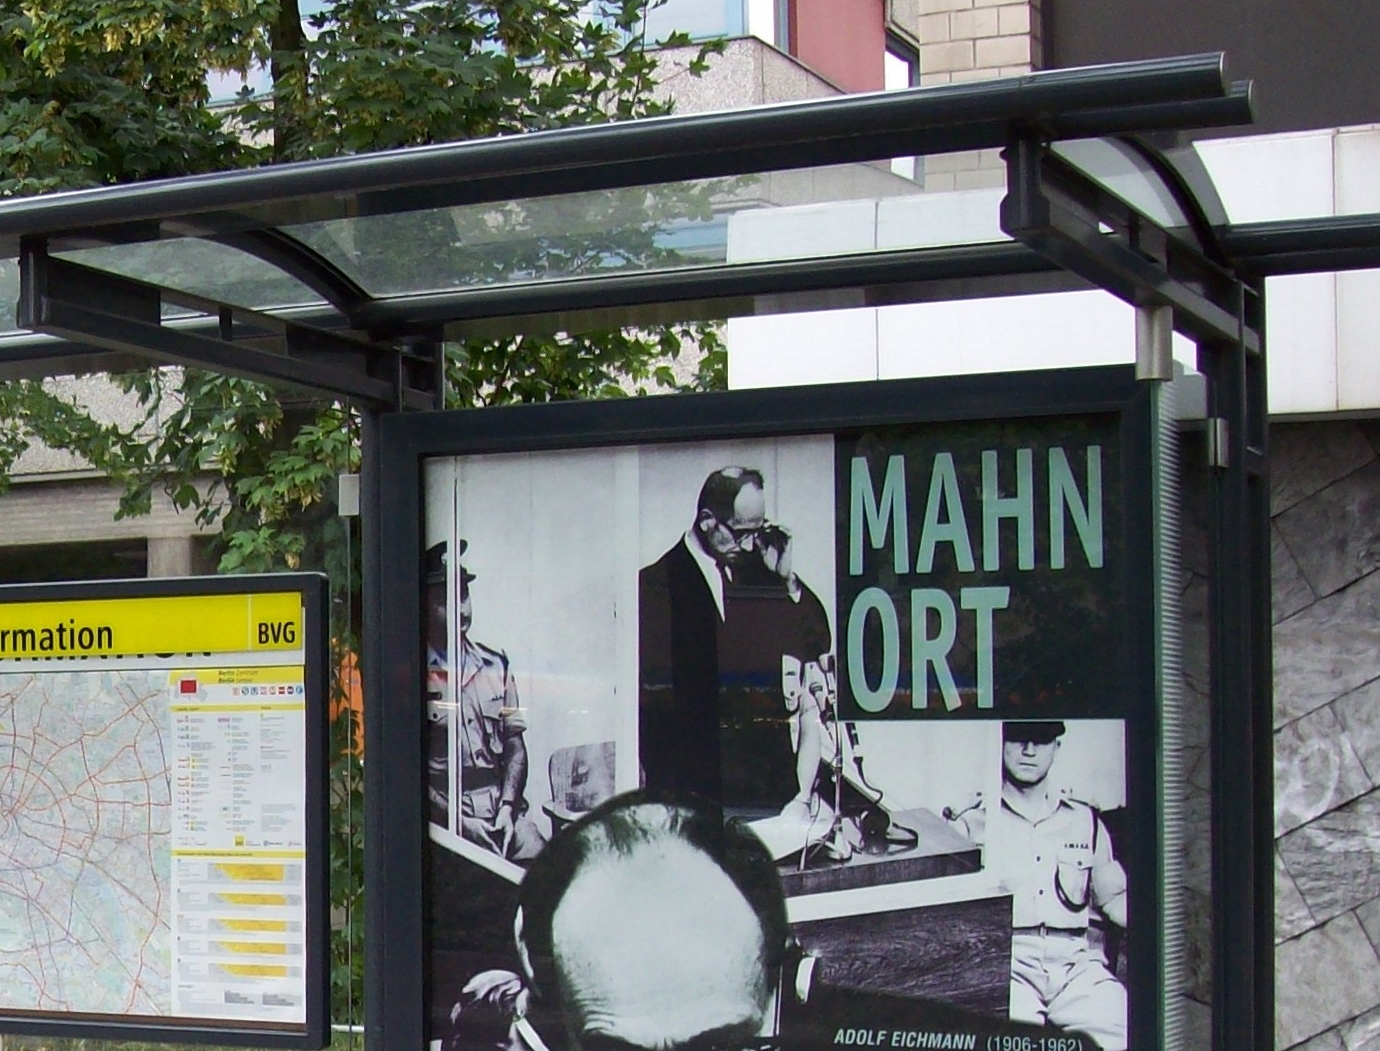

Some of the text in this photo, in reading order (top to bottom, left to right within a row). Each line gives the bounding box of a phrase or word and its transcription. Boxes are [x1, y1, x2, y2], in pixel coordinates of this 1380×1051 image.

[849, 445, 1103, 575] MAHN
[258, 621, 296, 646] BVG
[846, 587, 1010, 713] ORT
[834, 1029, 887, 1045] ADOLF
[892, 1031, 976, 1050] EICHMANN
